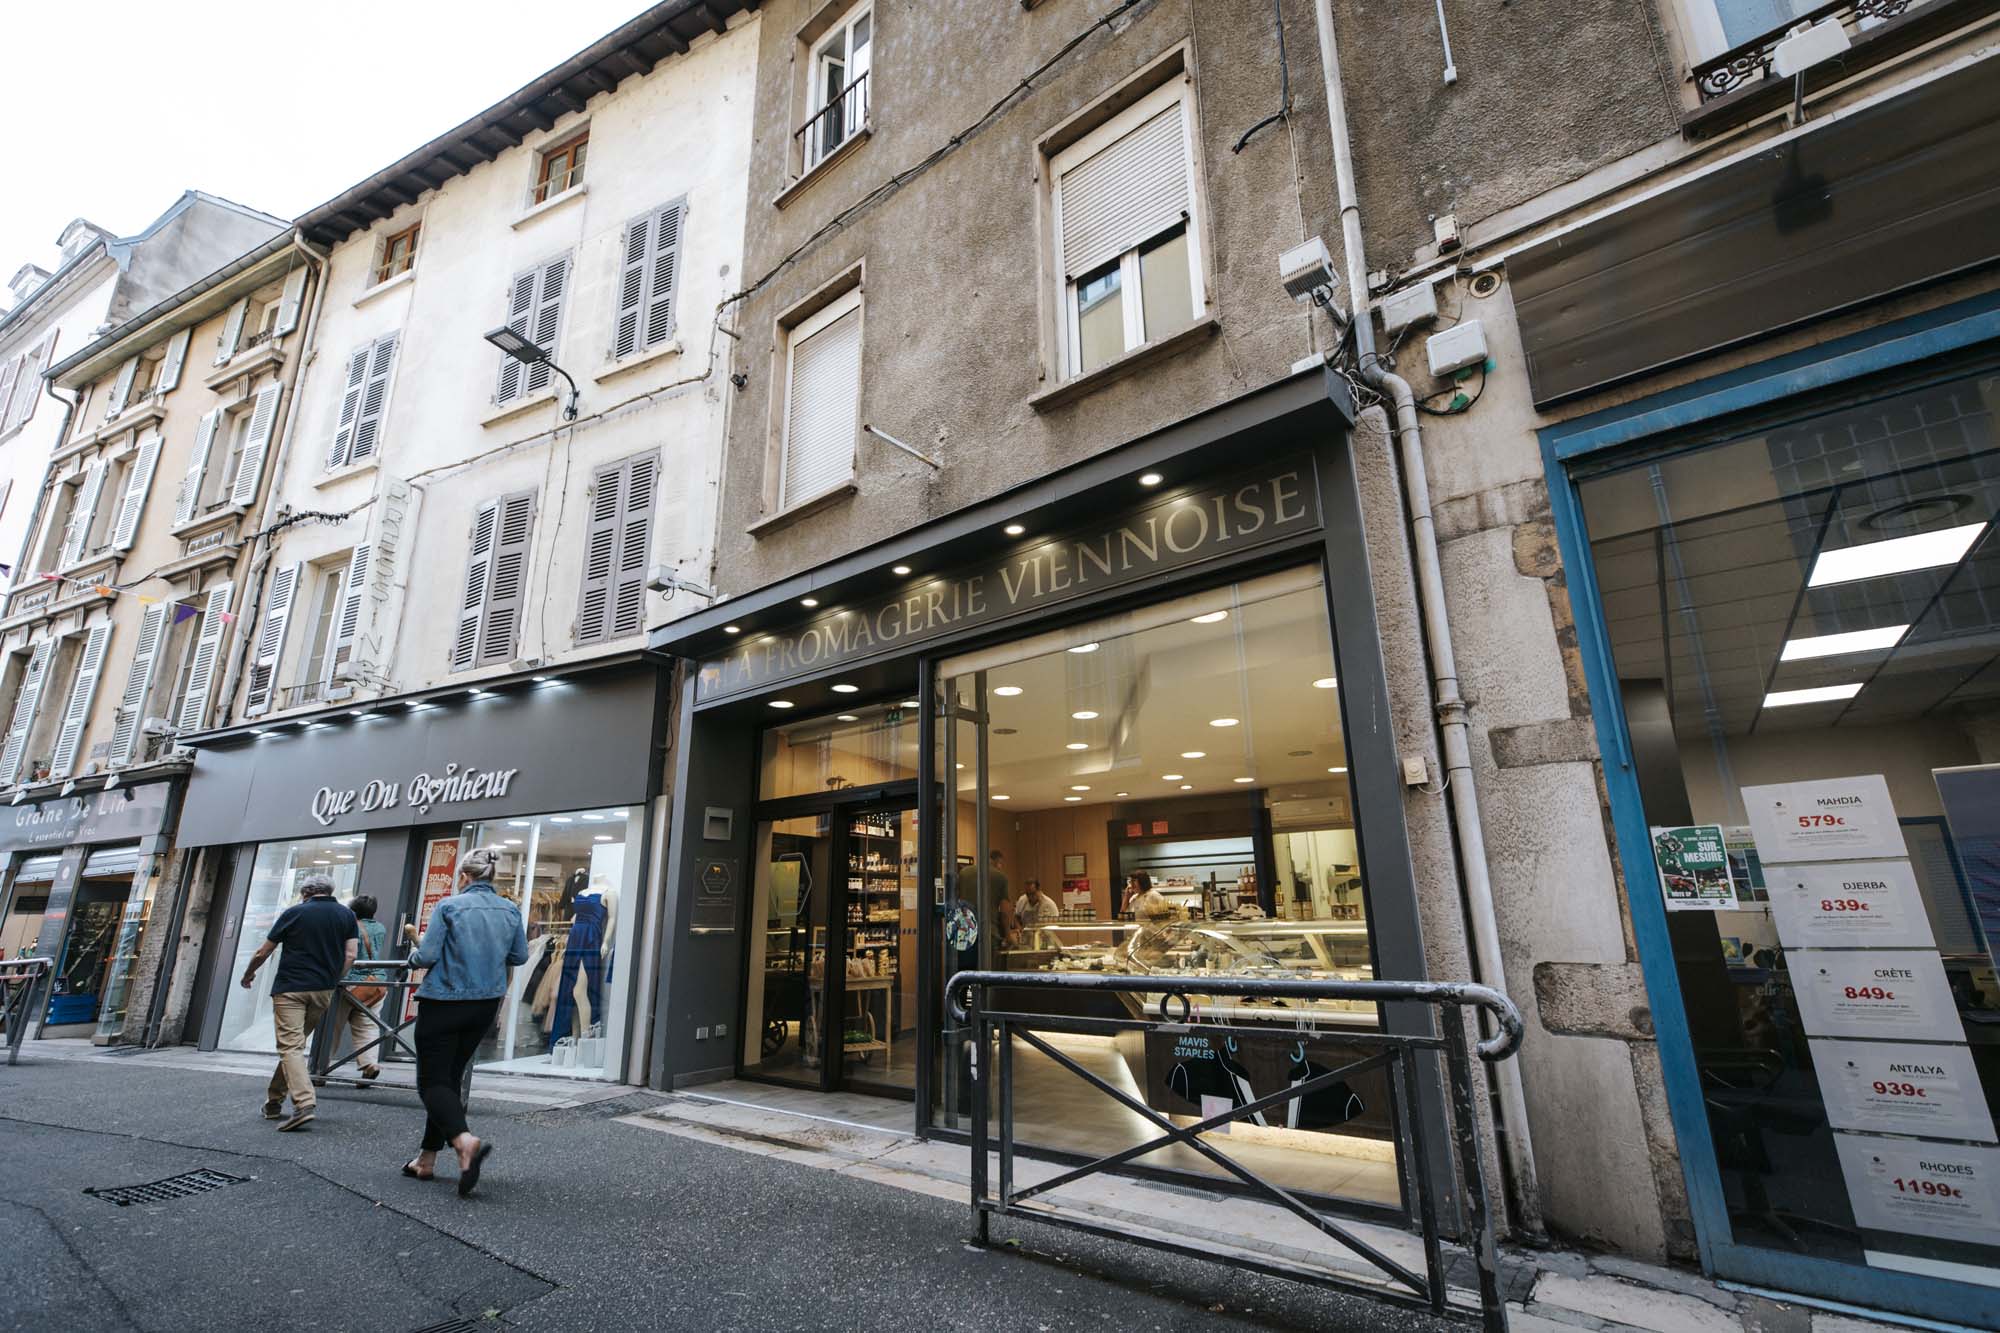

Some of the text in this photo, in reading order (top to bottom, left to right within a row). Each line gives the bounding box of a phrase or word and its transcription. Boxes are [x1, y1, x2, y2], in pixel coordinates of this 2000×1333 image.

[720, 471, 1306, 687] LA FROMAGERIE VIENNOISE
[311, 765, 517, 826] Que Du Bonheur
[1817, 796, 1862, 806] MAHDIA
[15, 793, 126, 828] Graine De Lin
[1798, 814, 1846, 827] 579€
[1697, 841, 1721, 852] SUR-
[1683, 852, 1724, 863] MESURE
[1843, 881, 1887, 890] DJERBA
[1820, 899, 1870, 912] 839€
[1874, 967, 1913, 978] CRÈTE
[1844, 986, 1896, 1000] 849€
[1178, 1036, 1209, 1048] MAVIS
[1174, 1046, 1215, 1060] STAPLES
[1889, 1063, 1945, 1075] ANTALYA
[1872, 1081, 1927, 1098] 939€
[1919, 1161, 1974, 1176] RHODES
[1893, 1178, 1964, 1199] 1199€
